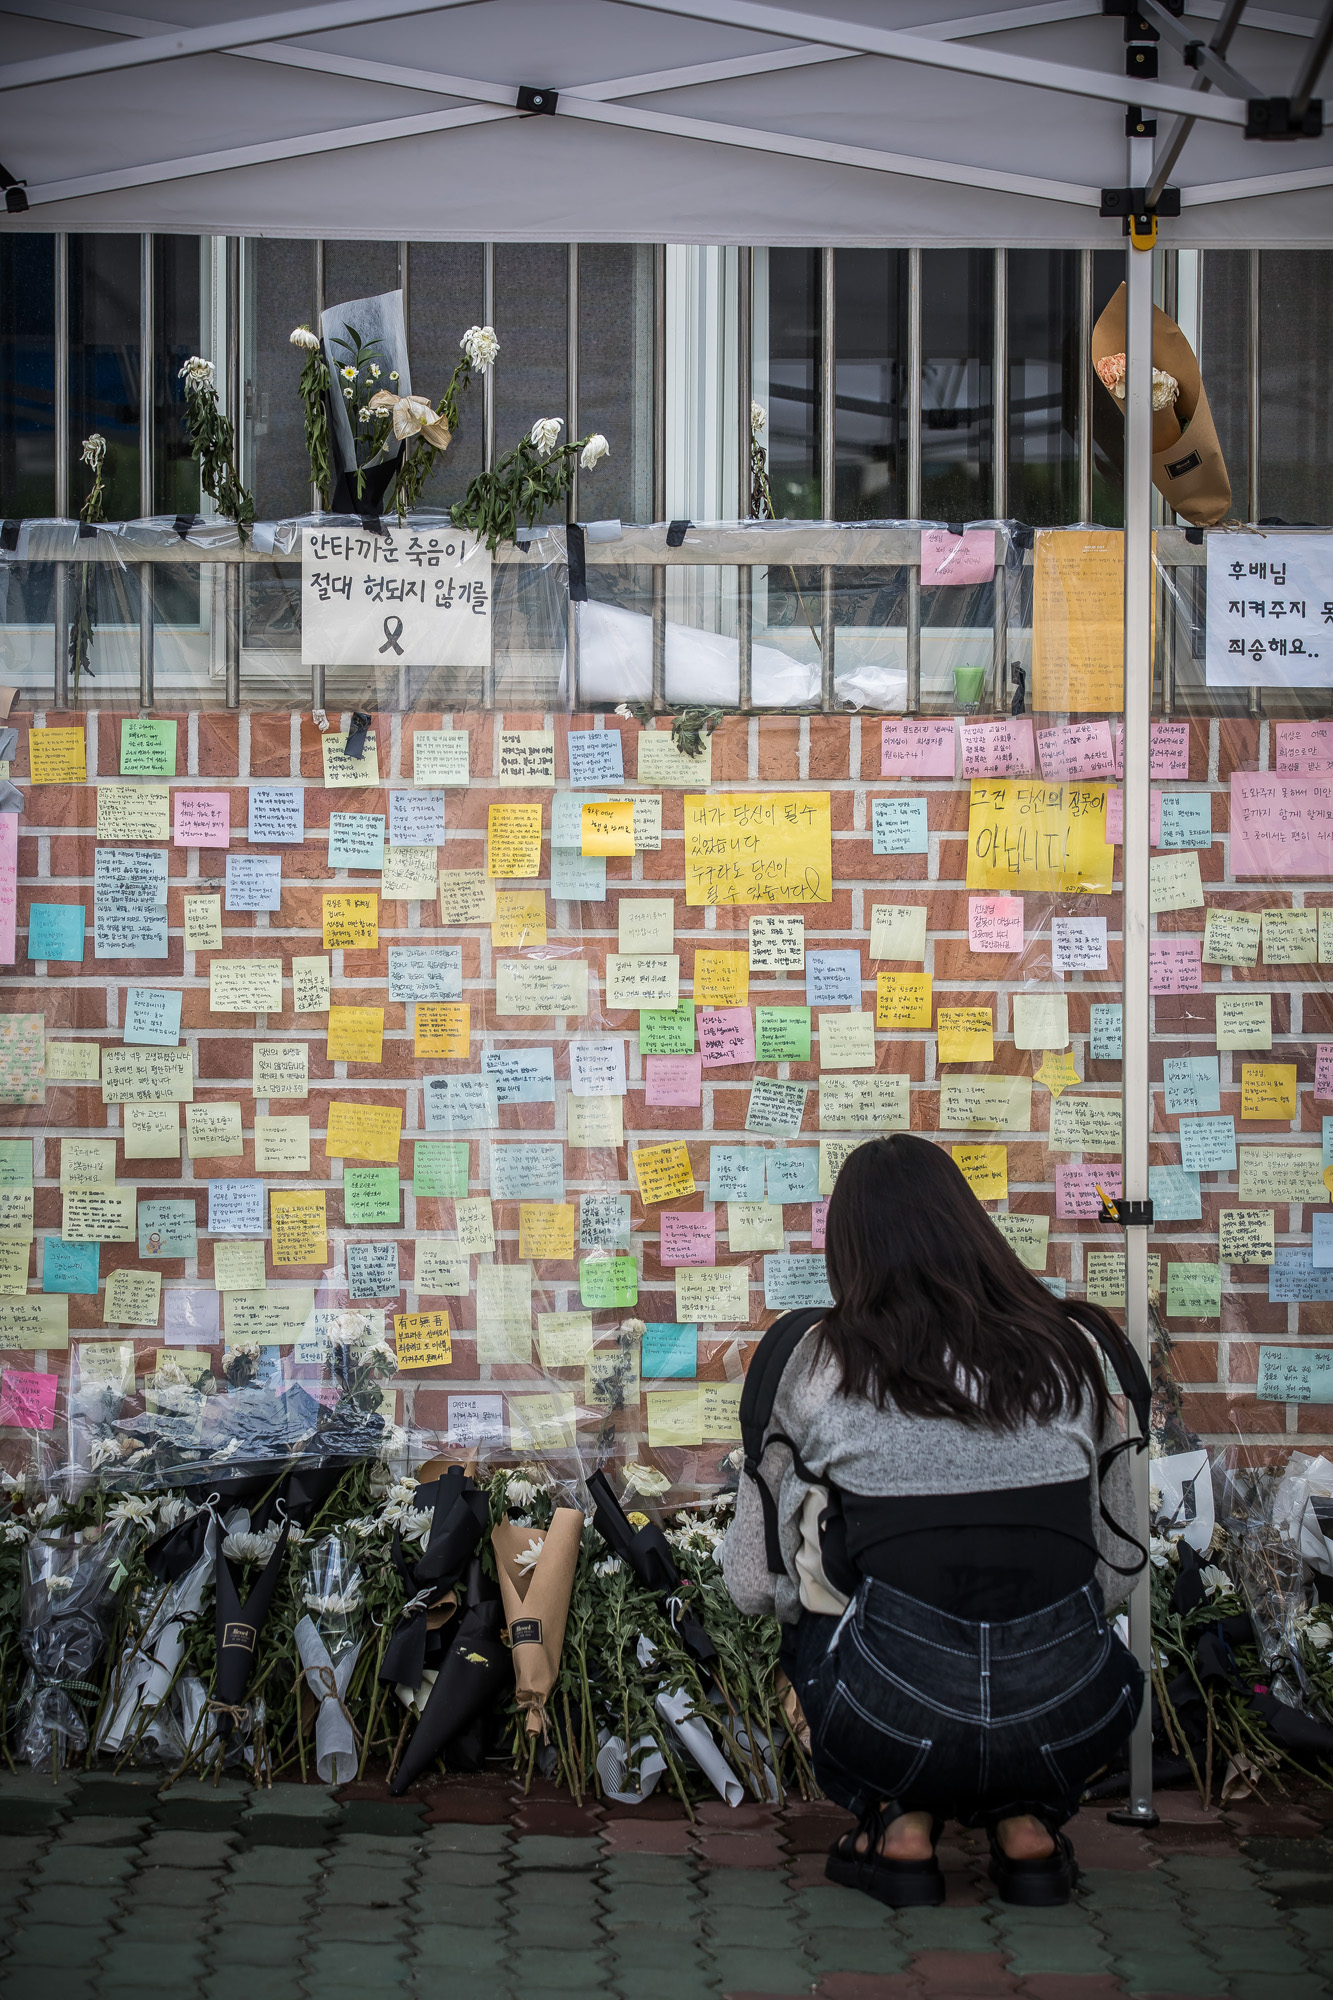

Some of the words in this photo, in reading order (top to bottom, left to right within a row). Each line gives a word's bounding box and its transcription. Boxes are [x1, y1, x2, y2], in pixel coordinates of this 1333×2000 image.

[310, 533, 399, 563] 안타까운
[405, 537, 465, 567] 죽음이
[1228, 561, 1286, 585] 후배님
[310, 573, 352, 601] 절대
[363, 574, 425, 603] 헛되지
[435, 577, 488, 615] 않기를
[1228, 600, 1306, 619] 지켜주지
[1017, 787, 1063, 814] 당신의
[693, 806, 725, 826] 내가
[734, 803, 775, 826] 당신이
[751, 857, 788, 880] 당신이
